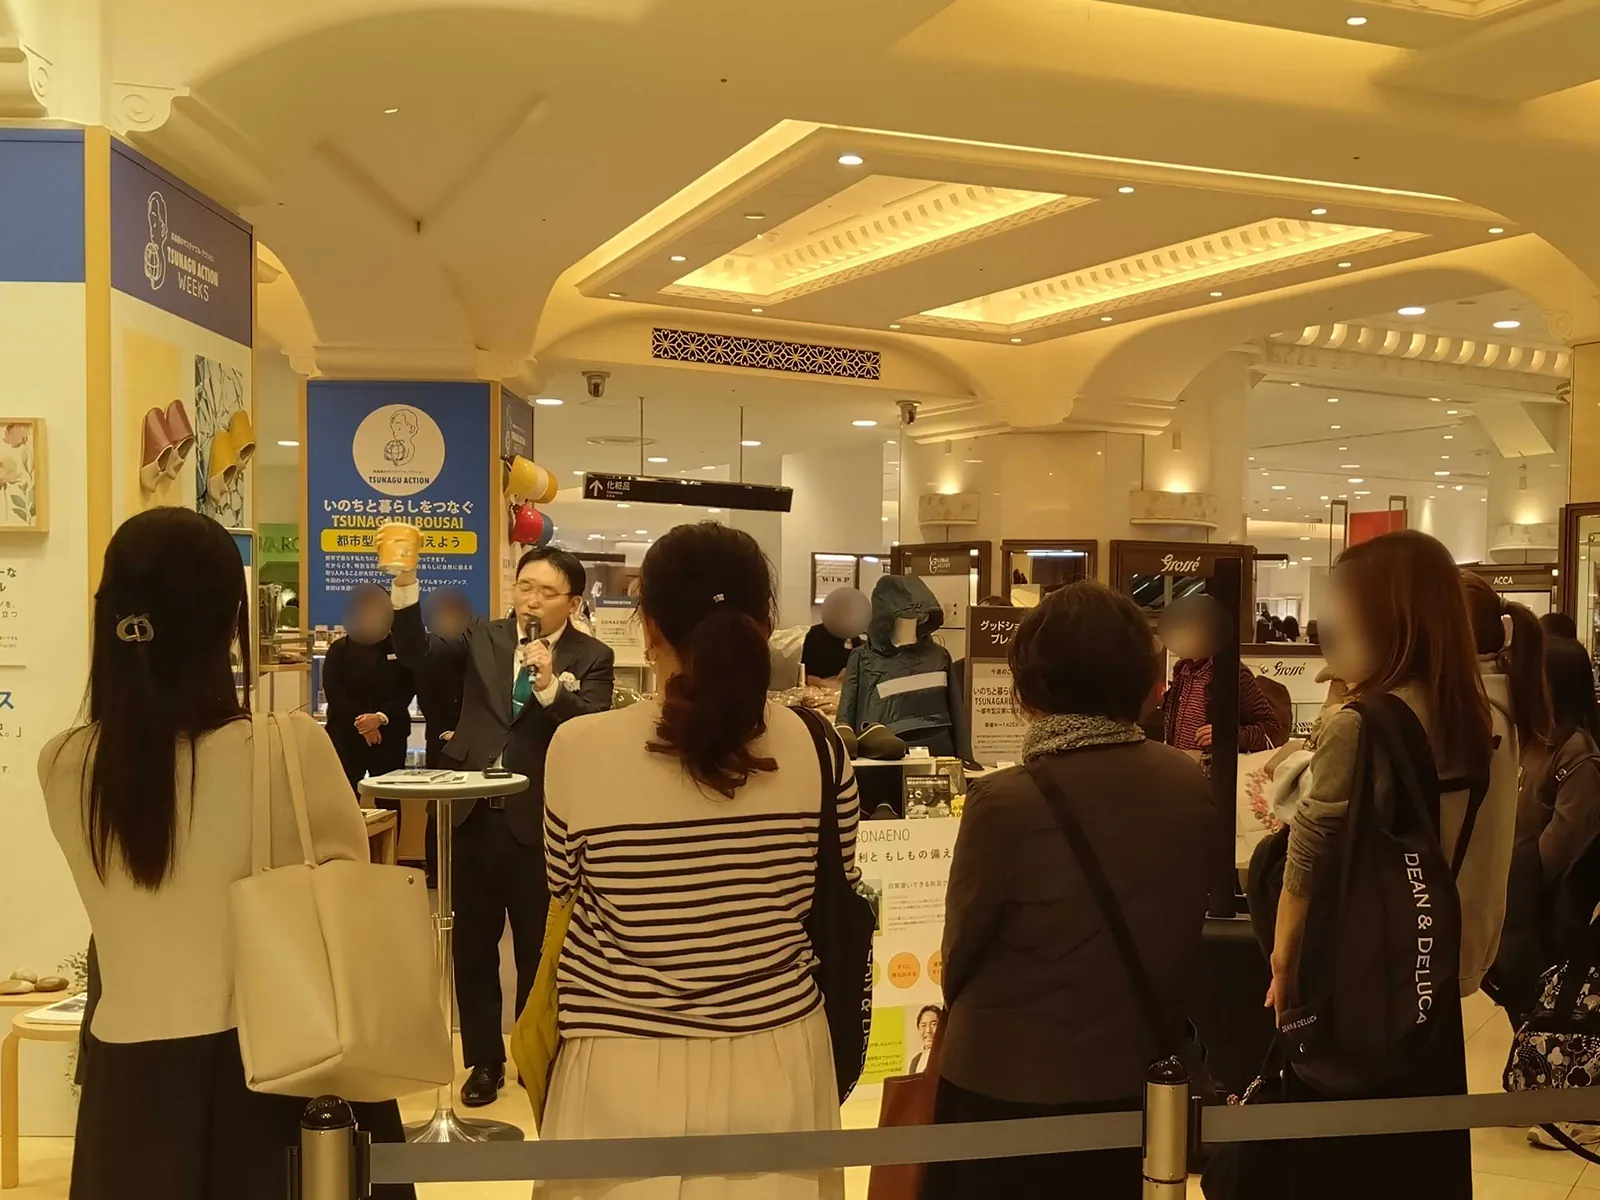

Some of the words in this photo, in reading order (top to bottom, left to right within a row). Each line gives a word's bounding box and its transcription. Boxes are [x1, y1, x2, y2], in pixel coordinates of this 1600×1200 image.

[167, 246, 197, 276] TSUNAGU
[196, 262, 219, 287] ACTION
[177, 271, 209, 302] WEEKS
[368, 476, 402, 485] TSUNAGU
[403, 476, 430, 485] ACTION
[324, 499, 474, 515] いのちと暮らしをつなぐ
[414, 516, 464, 530] BOUSAI
[1493, 576, 1514, 585] ACCA
[973, 686, 1012, 696] いのちと暮ら
[1404, 852, 1431, 908] DEAN
[1417, 914, 1433, 930] &
[1415, 937, 1434, 1024] DELUCA
